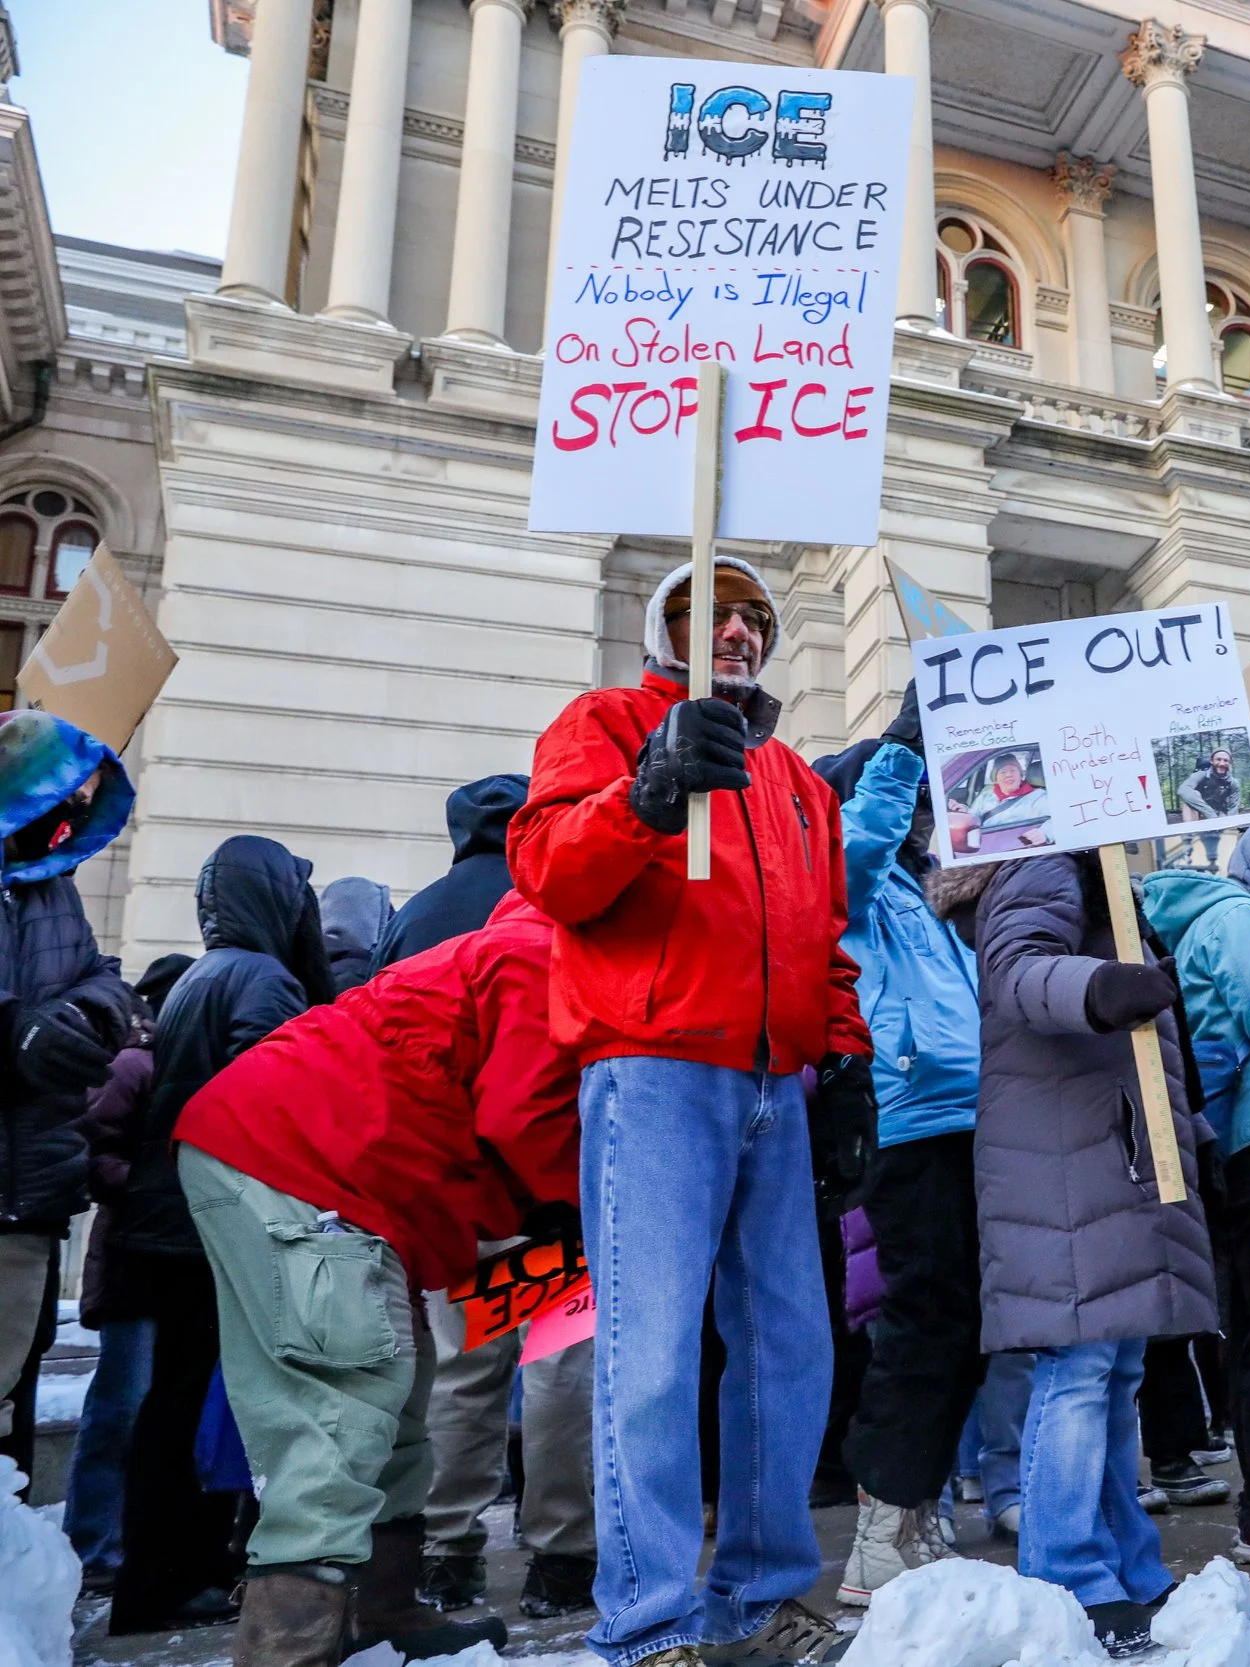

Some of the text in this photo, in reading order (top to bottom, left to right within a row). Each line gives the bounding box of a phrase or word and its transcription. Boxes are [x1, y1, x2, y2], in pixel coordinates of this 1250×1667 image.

[664, 82, 833, 169] ICE
[605, 176, 888, 212] MELTS UNDER
[611, 216, 879, 260] RESISTANCE
[576, 271, 868, 324] Nobody is Illegal
[556, 317, 855, 369] On Stolen Land
[553, 377, 875, 452] STOP ICE
[924, 605, 1229, 712] ICE OUT!
[1169, 696, 1239, 714] Remember
[933, 730, 1017, 754] Renee Good
[945, 718, 1018, 738] Remember
[1057, 720, 1118, 752] Both
[1169, 720, 1191, 733] Alex
[1051, 737, 1142, 778] Murdered
[1069, 775, 1153, 827] ICE!
[1092, 773, 1114, 798] by
